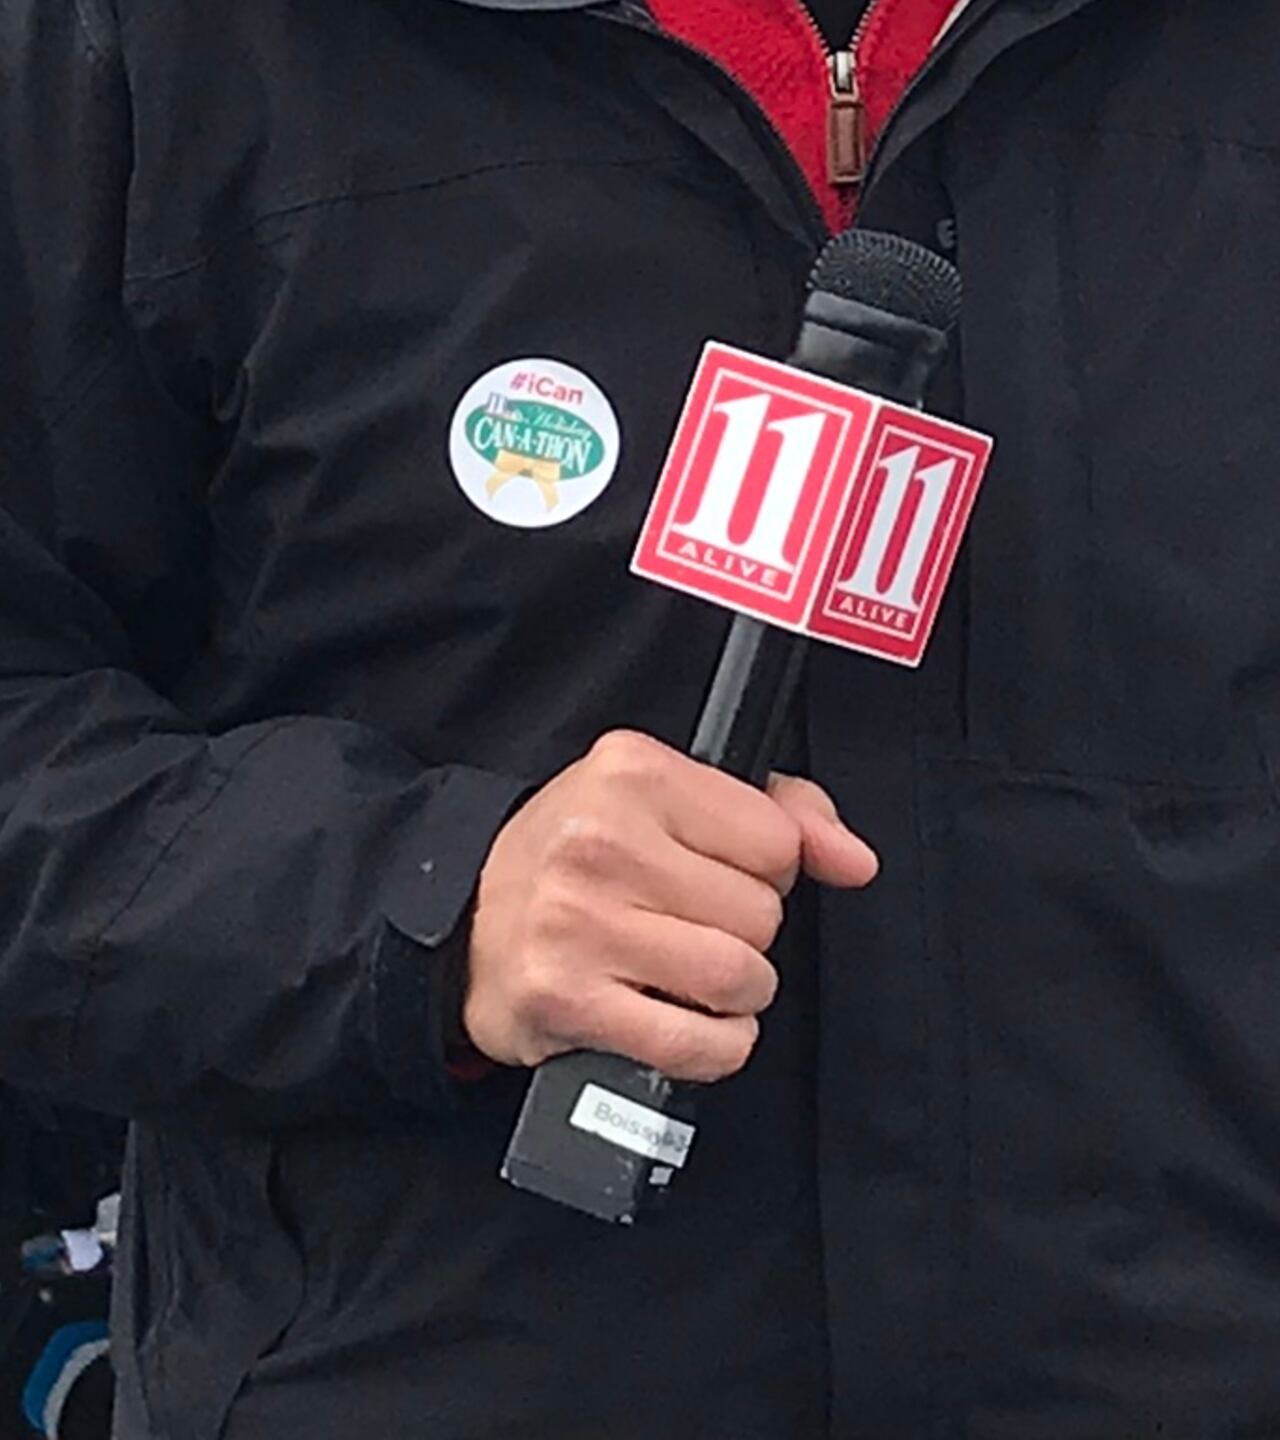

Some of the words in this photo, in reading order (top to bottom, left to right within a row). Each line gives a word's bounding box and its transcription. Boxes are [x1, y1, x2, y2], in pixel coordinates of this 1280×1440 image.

[510, 372, 585, 405] #iCan
[473, 415, 593, 474] CAN-A-THON
[670, 392, 827, 573] 11
[836, 444, 958, 614] 11
[677, 540, 780, 588] ALIVE
[839, 594, 910, 630] ALIVE
